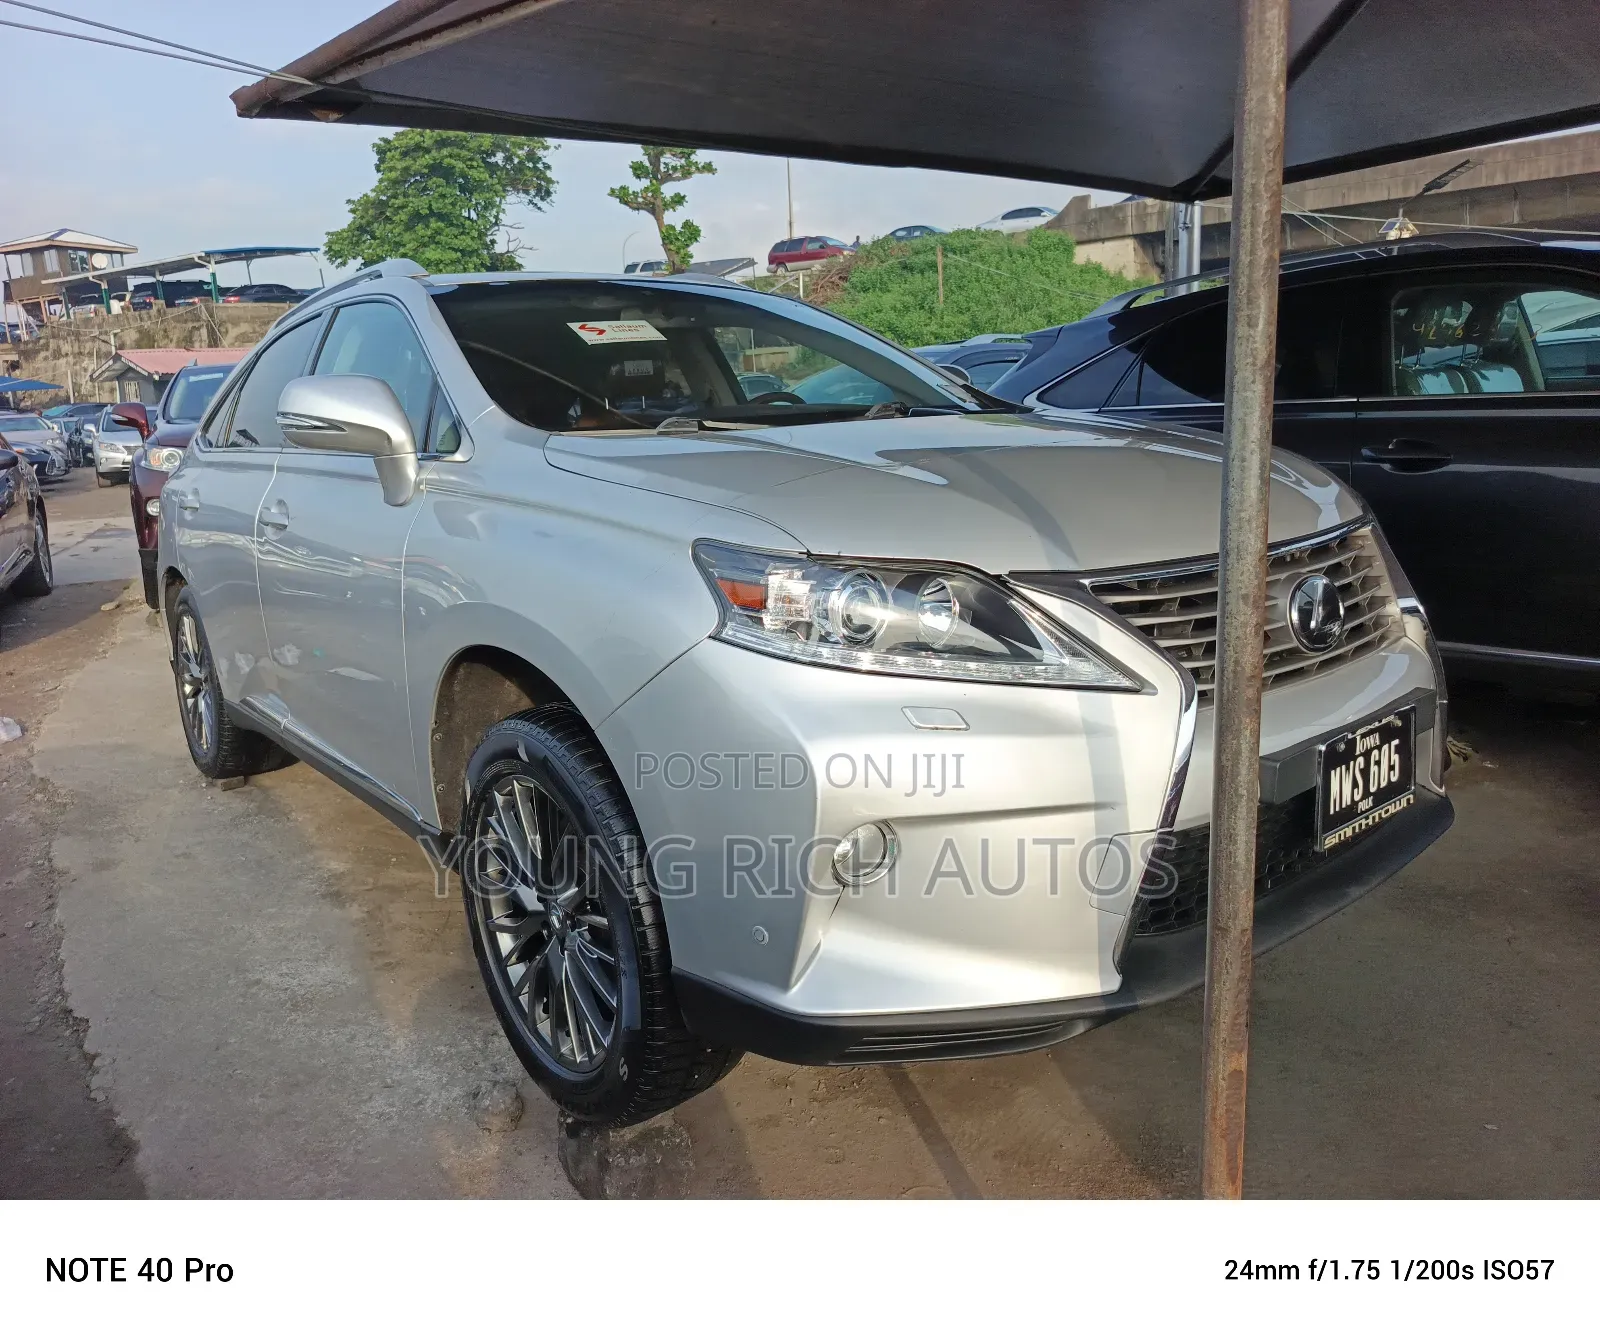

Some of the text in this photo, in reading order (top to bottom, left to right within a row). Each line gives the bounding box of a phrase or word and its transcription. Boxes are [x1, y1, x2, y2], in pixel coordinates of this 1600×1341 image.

[1329, 739, 1400, 815] MWS 605
[1357, 796, 1374, 814] POLK
